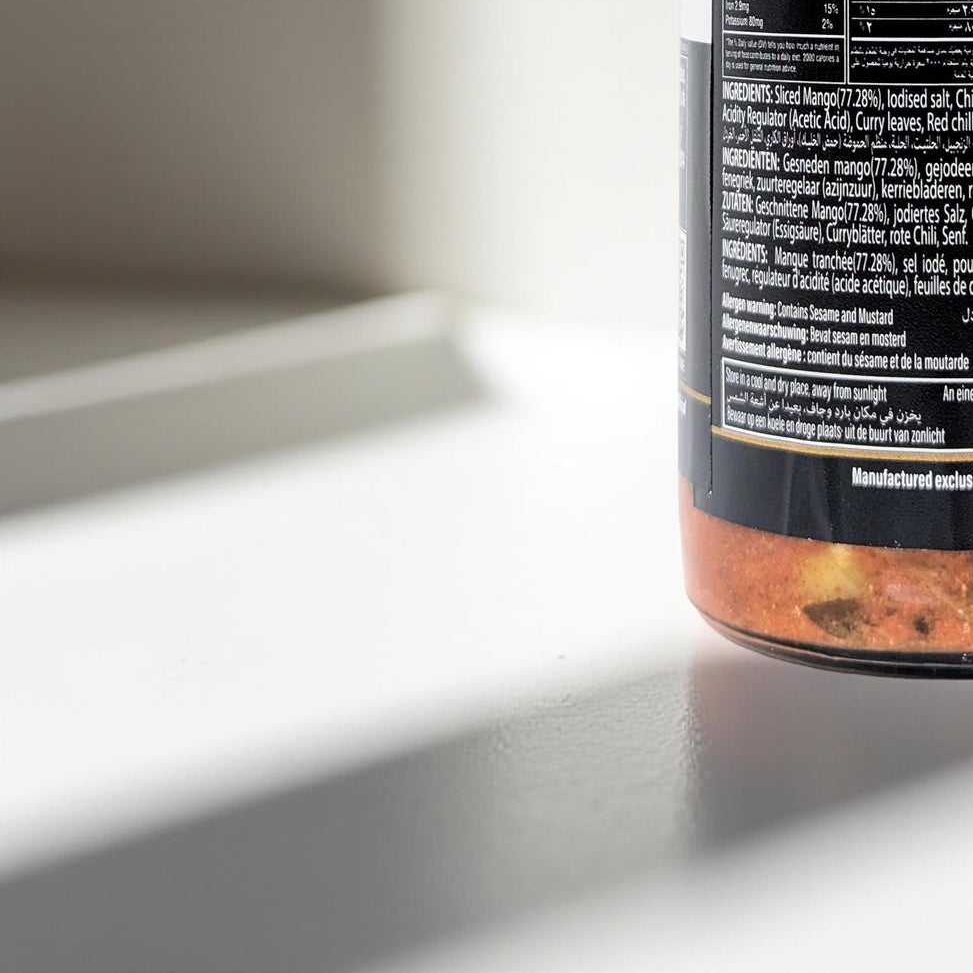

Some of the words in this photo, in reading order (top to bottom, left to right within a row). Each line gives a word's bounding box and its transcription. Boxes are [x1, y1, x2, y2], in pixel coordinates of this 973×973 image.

[722, 81, 774, 104] INGREDIENTS:
[774, 85, 800, 105] Sliced
[802, 87, 884, 111] Mango(77.28%),
[888, 89, 928, 109] Iodised
[930, 89, 952, 110] salt,
[722, 103, 746, 126] Acidity
[748, 105, 787, 131] Regulator
[788, 108, 822, 131] (Acetic
[824, 109, 853, 132] Acid),
[855, 111, 885, 135] Curry
[888, 112, 924, 133] leaves,
[927, 112, 948, 131] Red
[782, 153, 830, 175] Gesneden
[834, 157, 921, 181] mango(77.28%),
[722, 191, 754, 212] ZUTATEN:
[755, 195, 808, 219] Geschnittene
[811, 201, 890, 225] Mango(77.28%),
[893, 203, 940, 227] jodiertes
[944, 203, 968, 226] Salz,
[722, 292, 747, 314] Allergen
[748, 299, 777, 319] warning:
[778, 301, 808, 320] Contains
[809, 304, 840, 323] Sesame
[841, 306, 856, 324] and
[858, 307, 894, 325] Mustard
[852, 467, 933, 489] Manufactured
